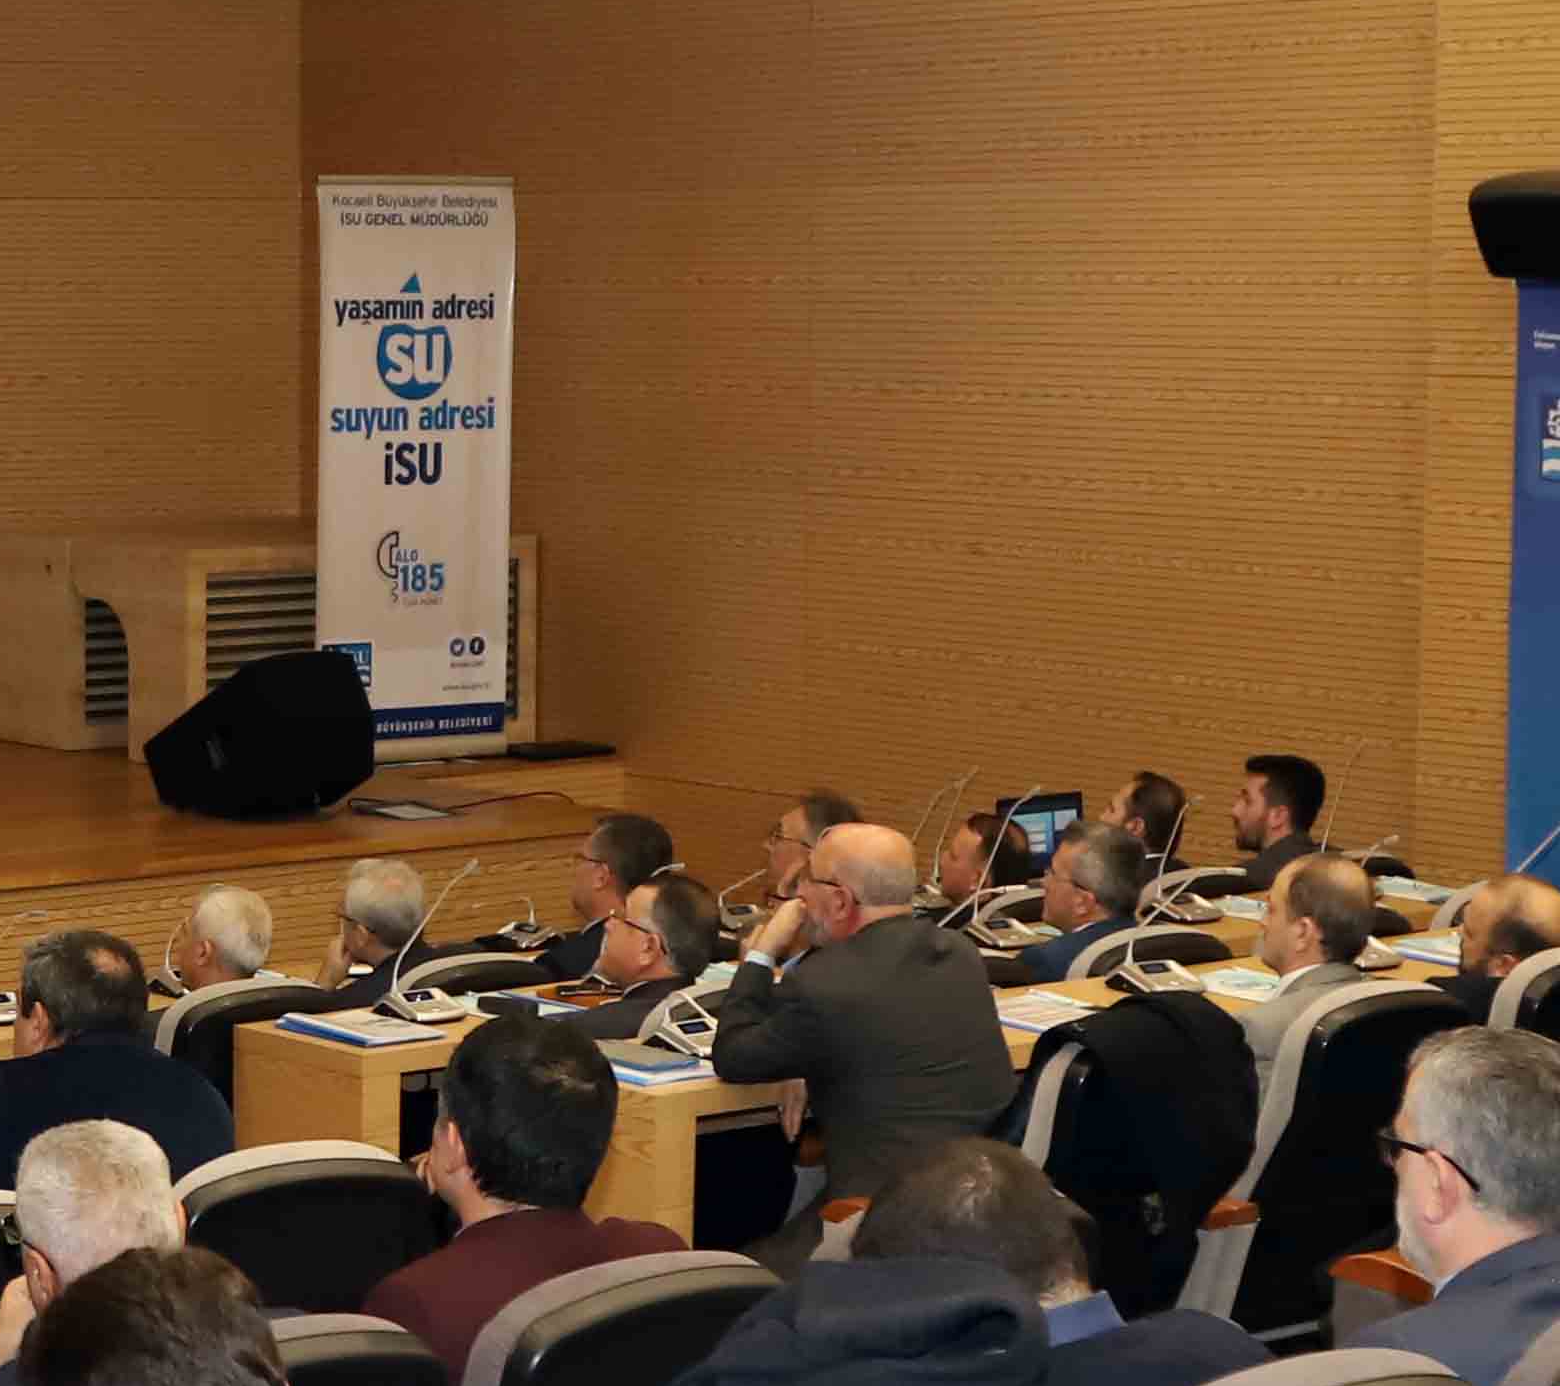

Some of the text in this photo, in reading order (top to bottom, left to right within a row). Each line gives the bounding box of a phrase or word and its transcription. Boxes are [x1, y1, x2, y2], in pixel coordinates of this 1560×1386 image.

[365, 213, 406, 226] GENEL
[335, 293, 495, 327] yaşamın adresi
[385, 333, 445, 384] SU
[331, 397, 495, 439] suyun adresi
[395, 549, 418, 562] ALO
[400, 564, 445, 592] 185
